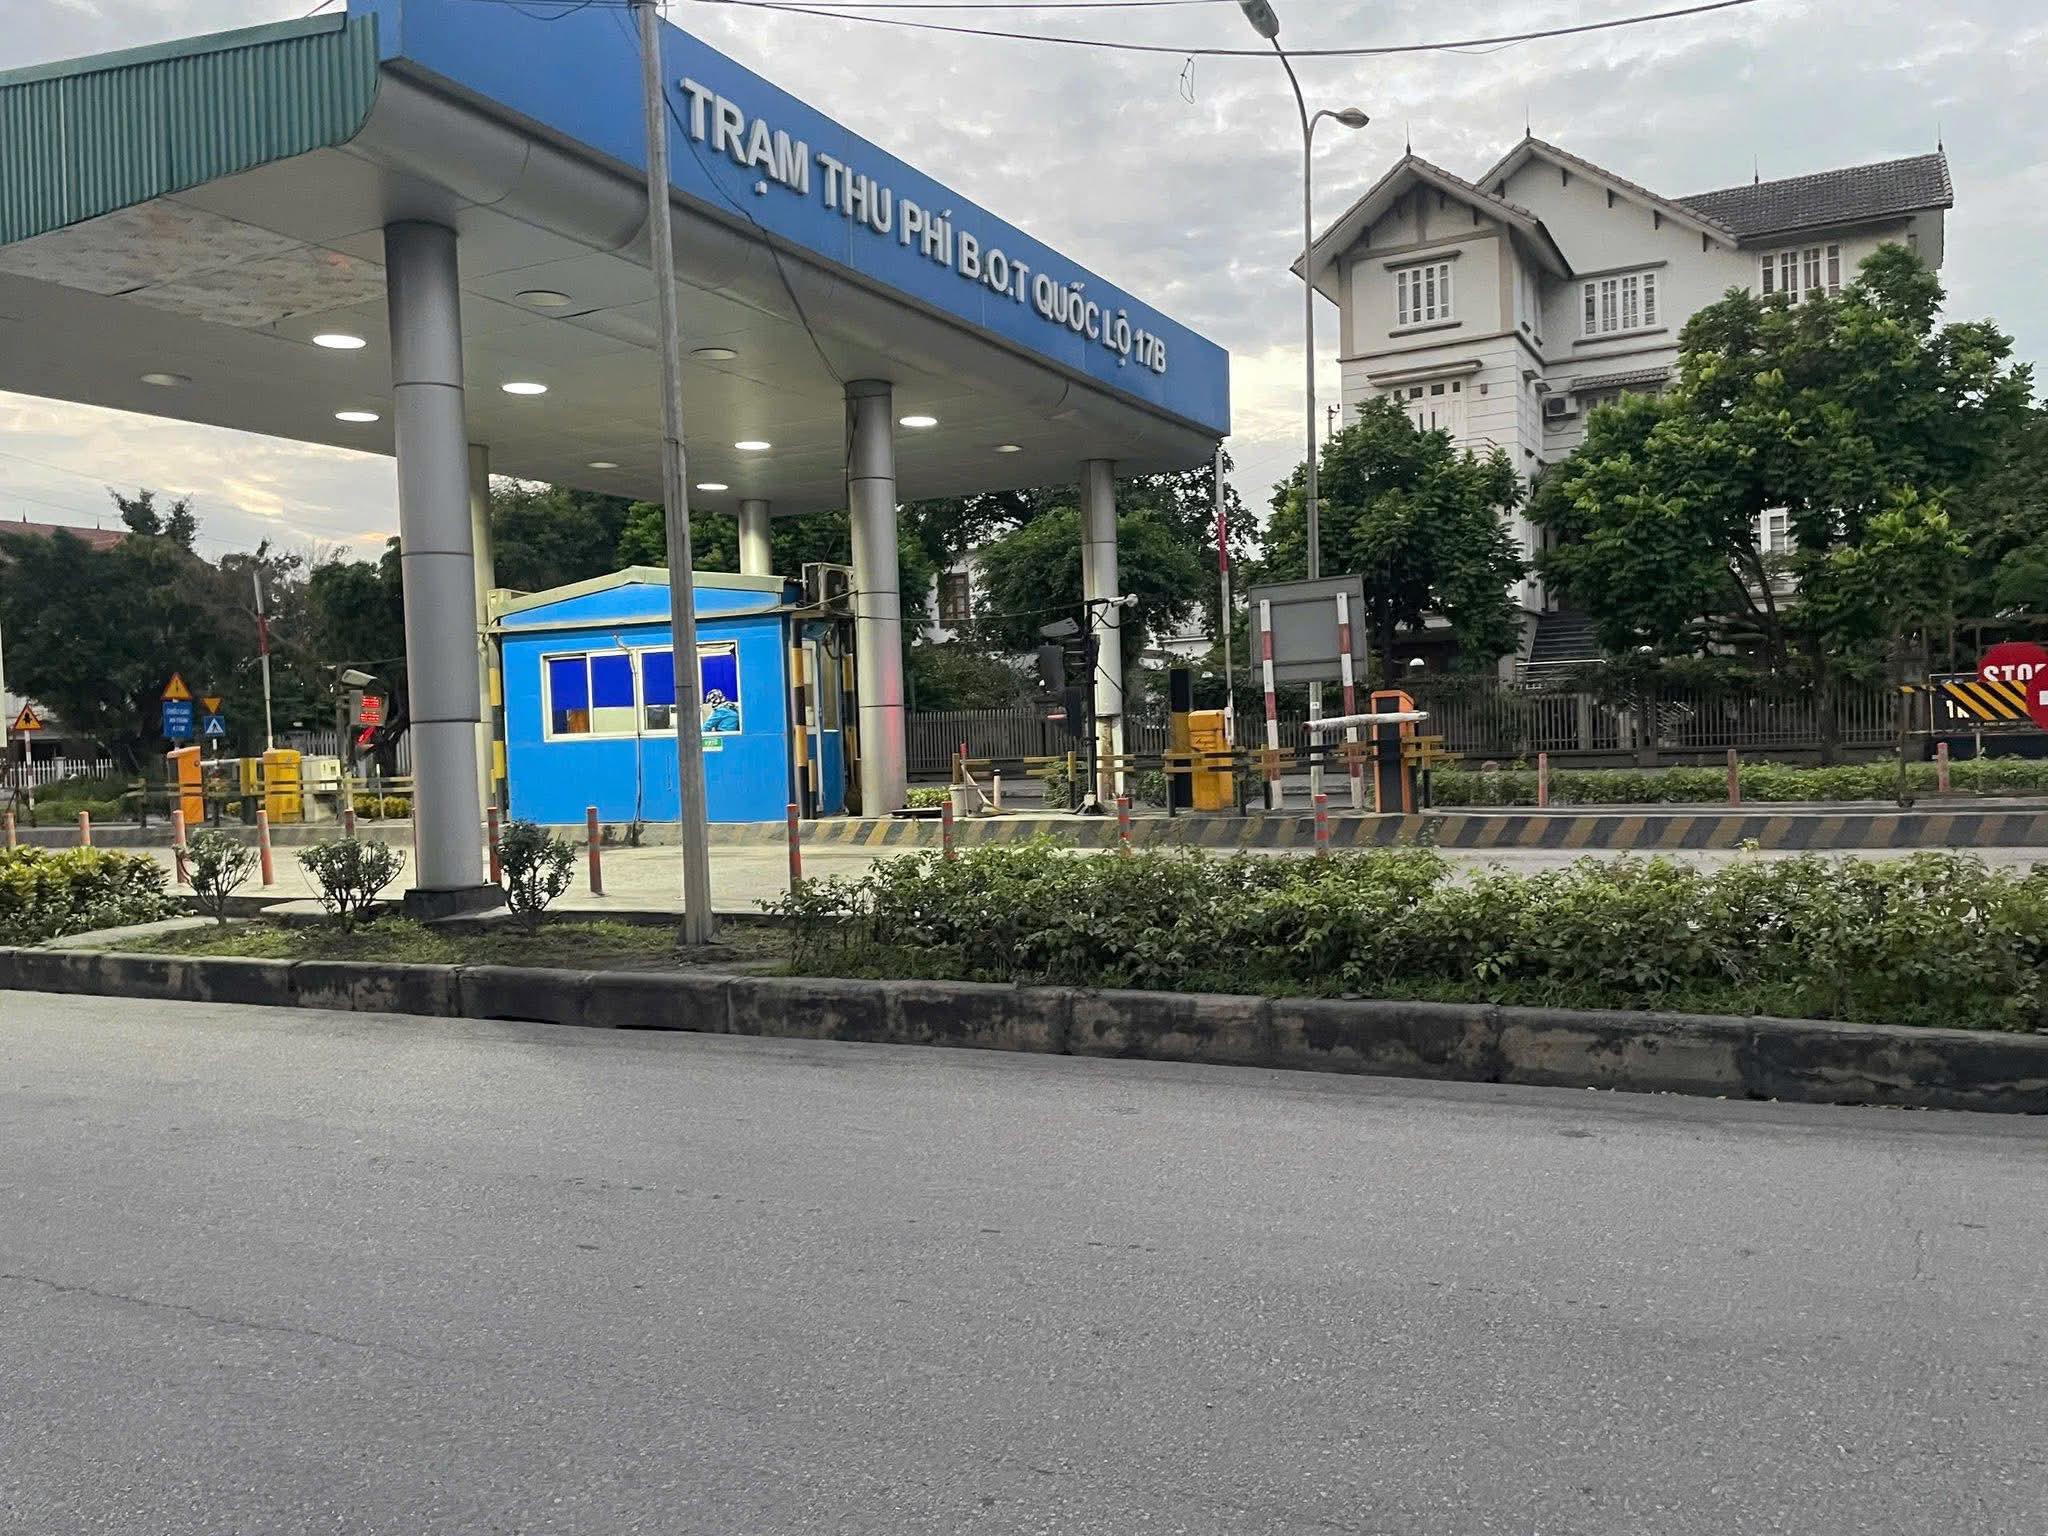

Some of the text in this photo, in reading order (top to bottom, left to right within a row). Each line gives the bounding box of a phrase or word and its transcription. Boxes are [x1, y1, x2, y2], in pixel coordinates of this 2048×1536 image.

[680, 77, 1167, 374] TRẠM THU PHÍ B.O.T QUỐC LỘ 17B
[1983, 663, 2047, 682] STO
